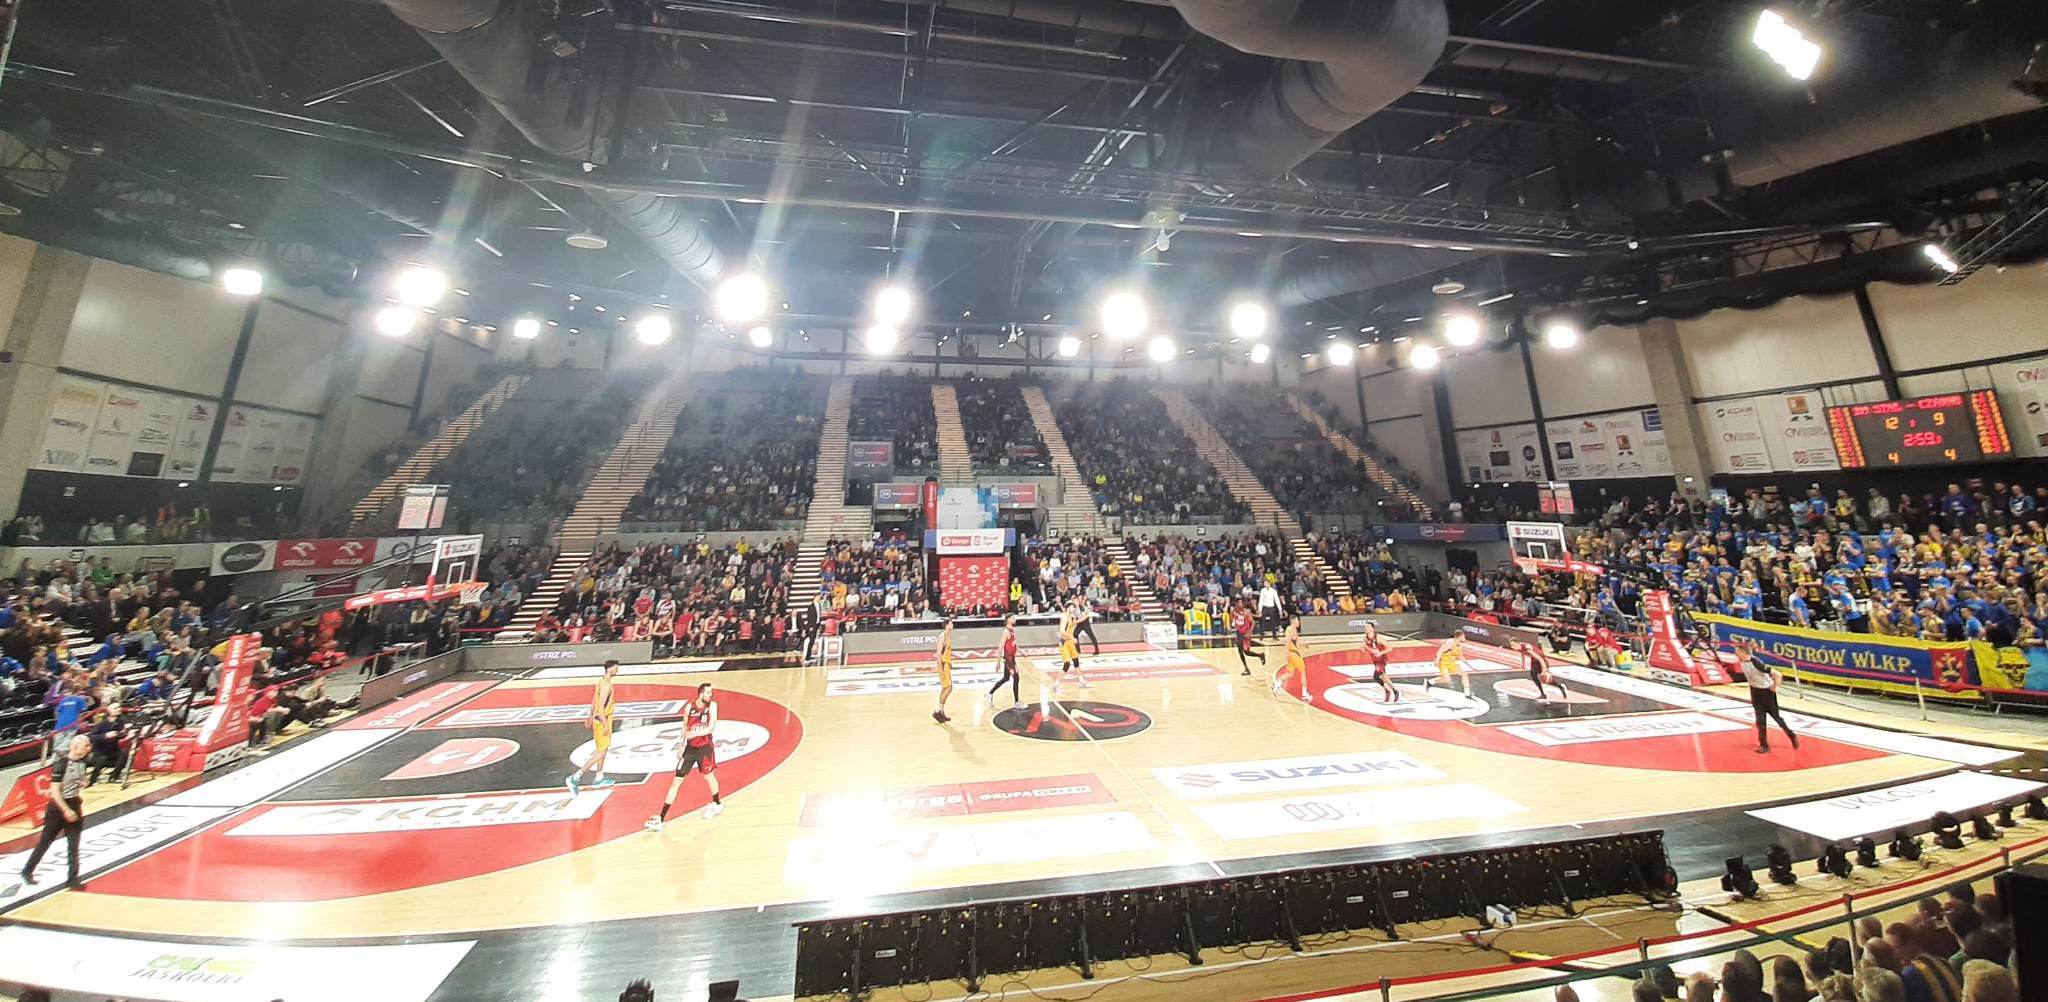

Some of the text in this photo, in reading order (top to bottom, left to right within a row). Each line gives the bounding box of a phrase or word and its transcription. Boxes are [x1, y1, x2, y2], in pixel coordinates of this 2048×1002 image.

[1885, 417, 1898, 430] 12
[1934, 412, 1946, 426] 9
[1887, 452, 1900, 464] 4
[1944, 448, 1957, 461] 4
[332, 557, 364, 566] ORLEN
[1773, 641, 1846, 666] OSTRÓW
[1851, 649, 1917, 675] WLKP.
[1230, 760, 1419, 782] SUZUKI
[979, 791, 1034, 808] GRUPA
[375, 798, 574, 821] KGHM
